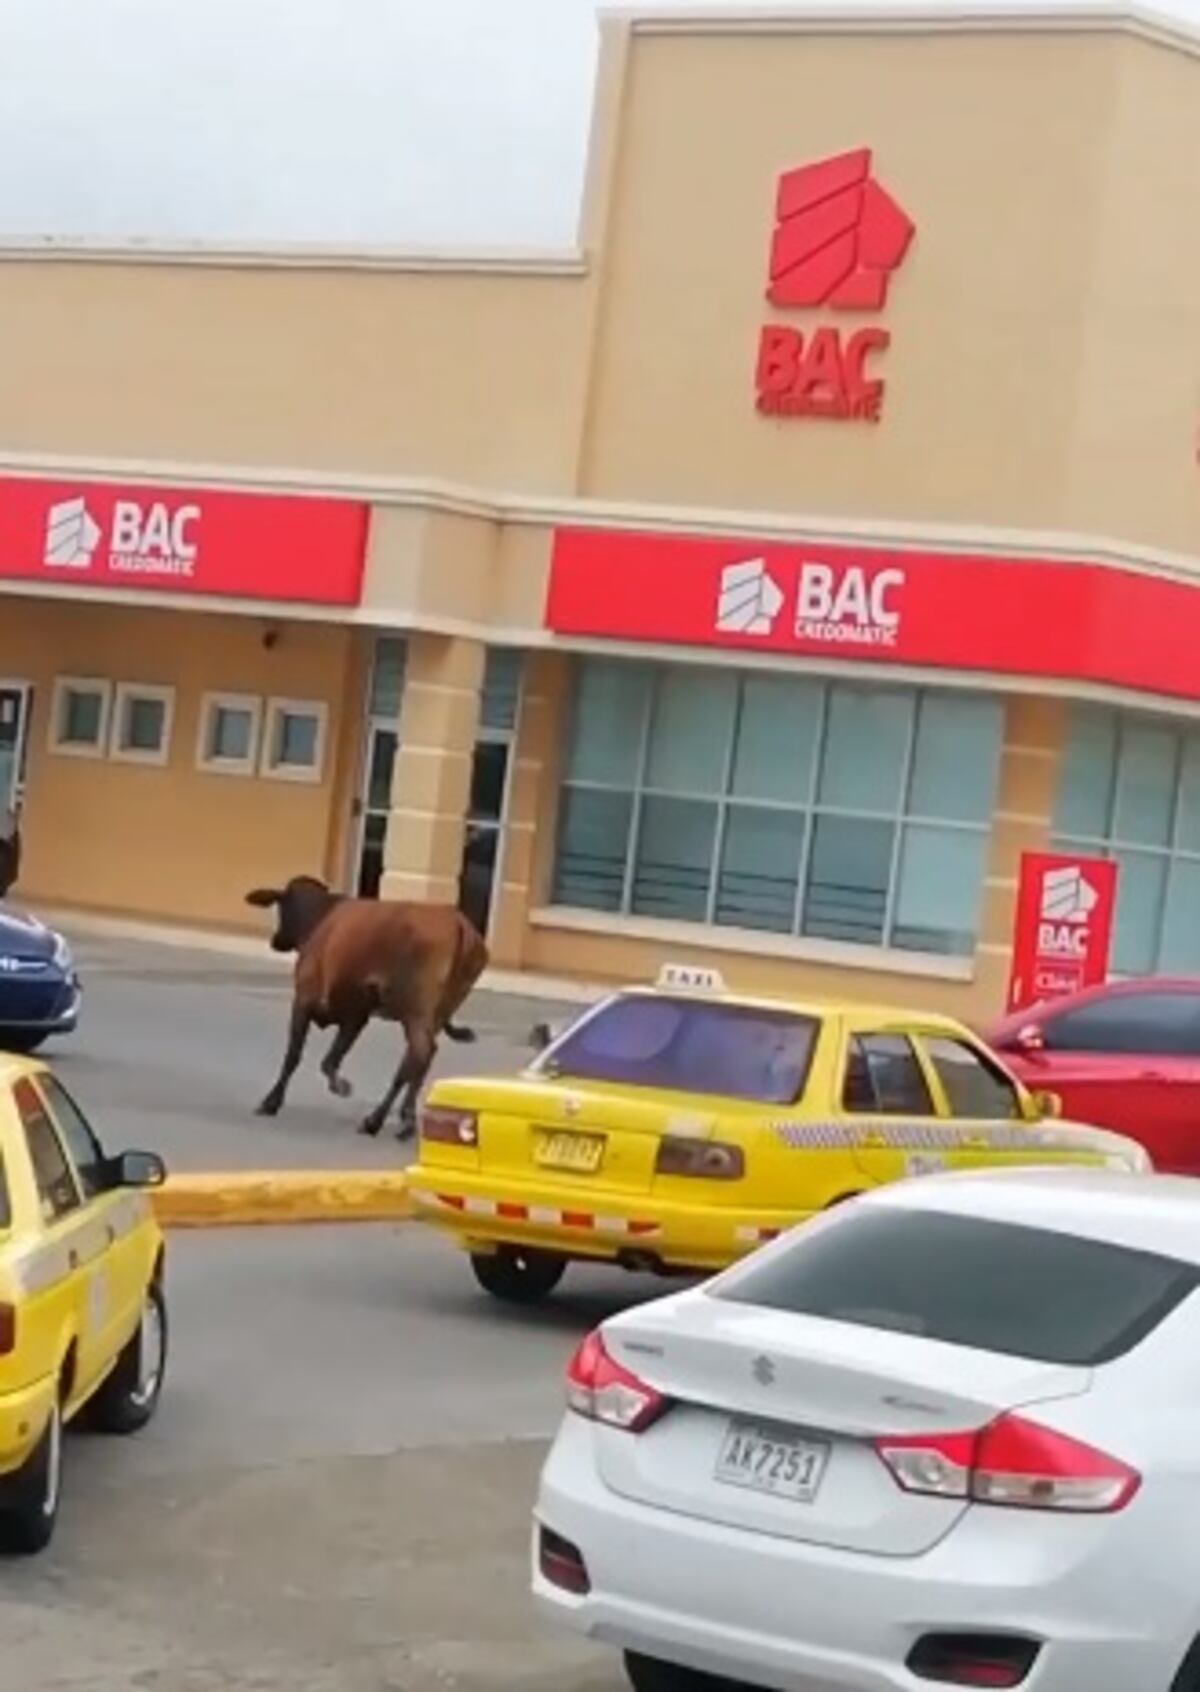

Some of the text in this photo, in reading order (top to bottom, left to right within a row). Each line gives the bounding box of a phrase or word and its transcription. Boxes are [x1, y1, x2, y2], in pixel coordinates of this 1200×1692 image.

[756, 325, 890, 402] BAC
[111, 500, 201, 558] BAC
[797, 563, 904, 625] BAC
[1037, 922, 1090, 954] BAC
[665, 968, 713, 987] TAXI
[725, 1436, 816, 1486] AK7251
